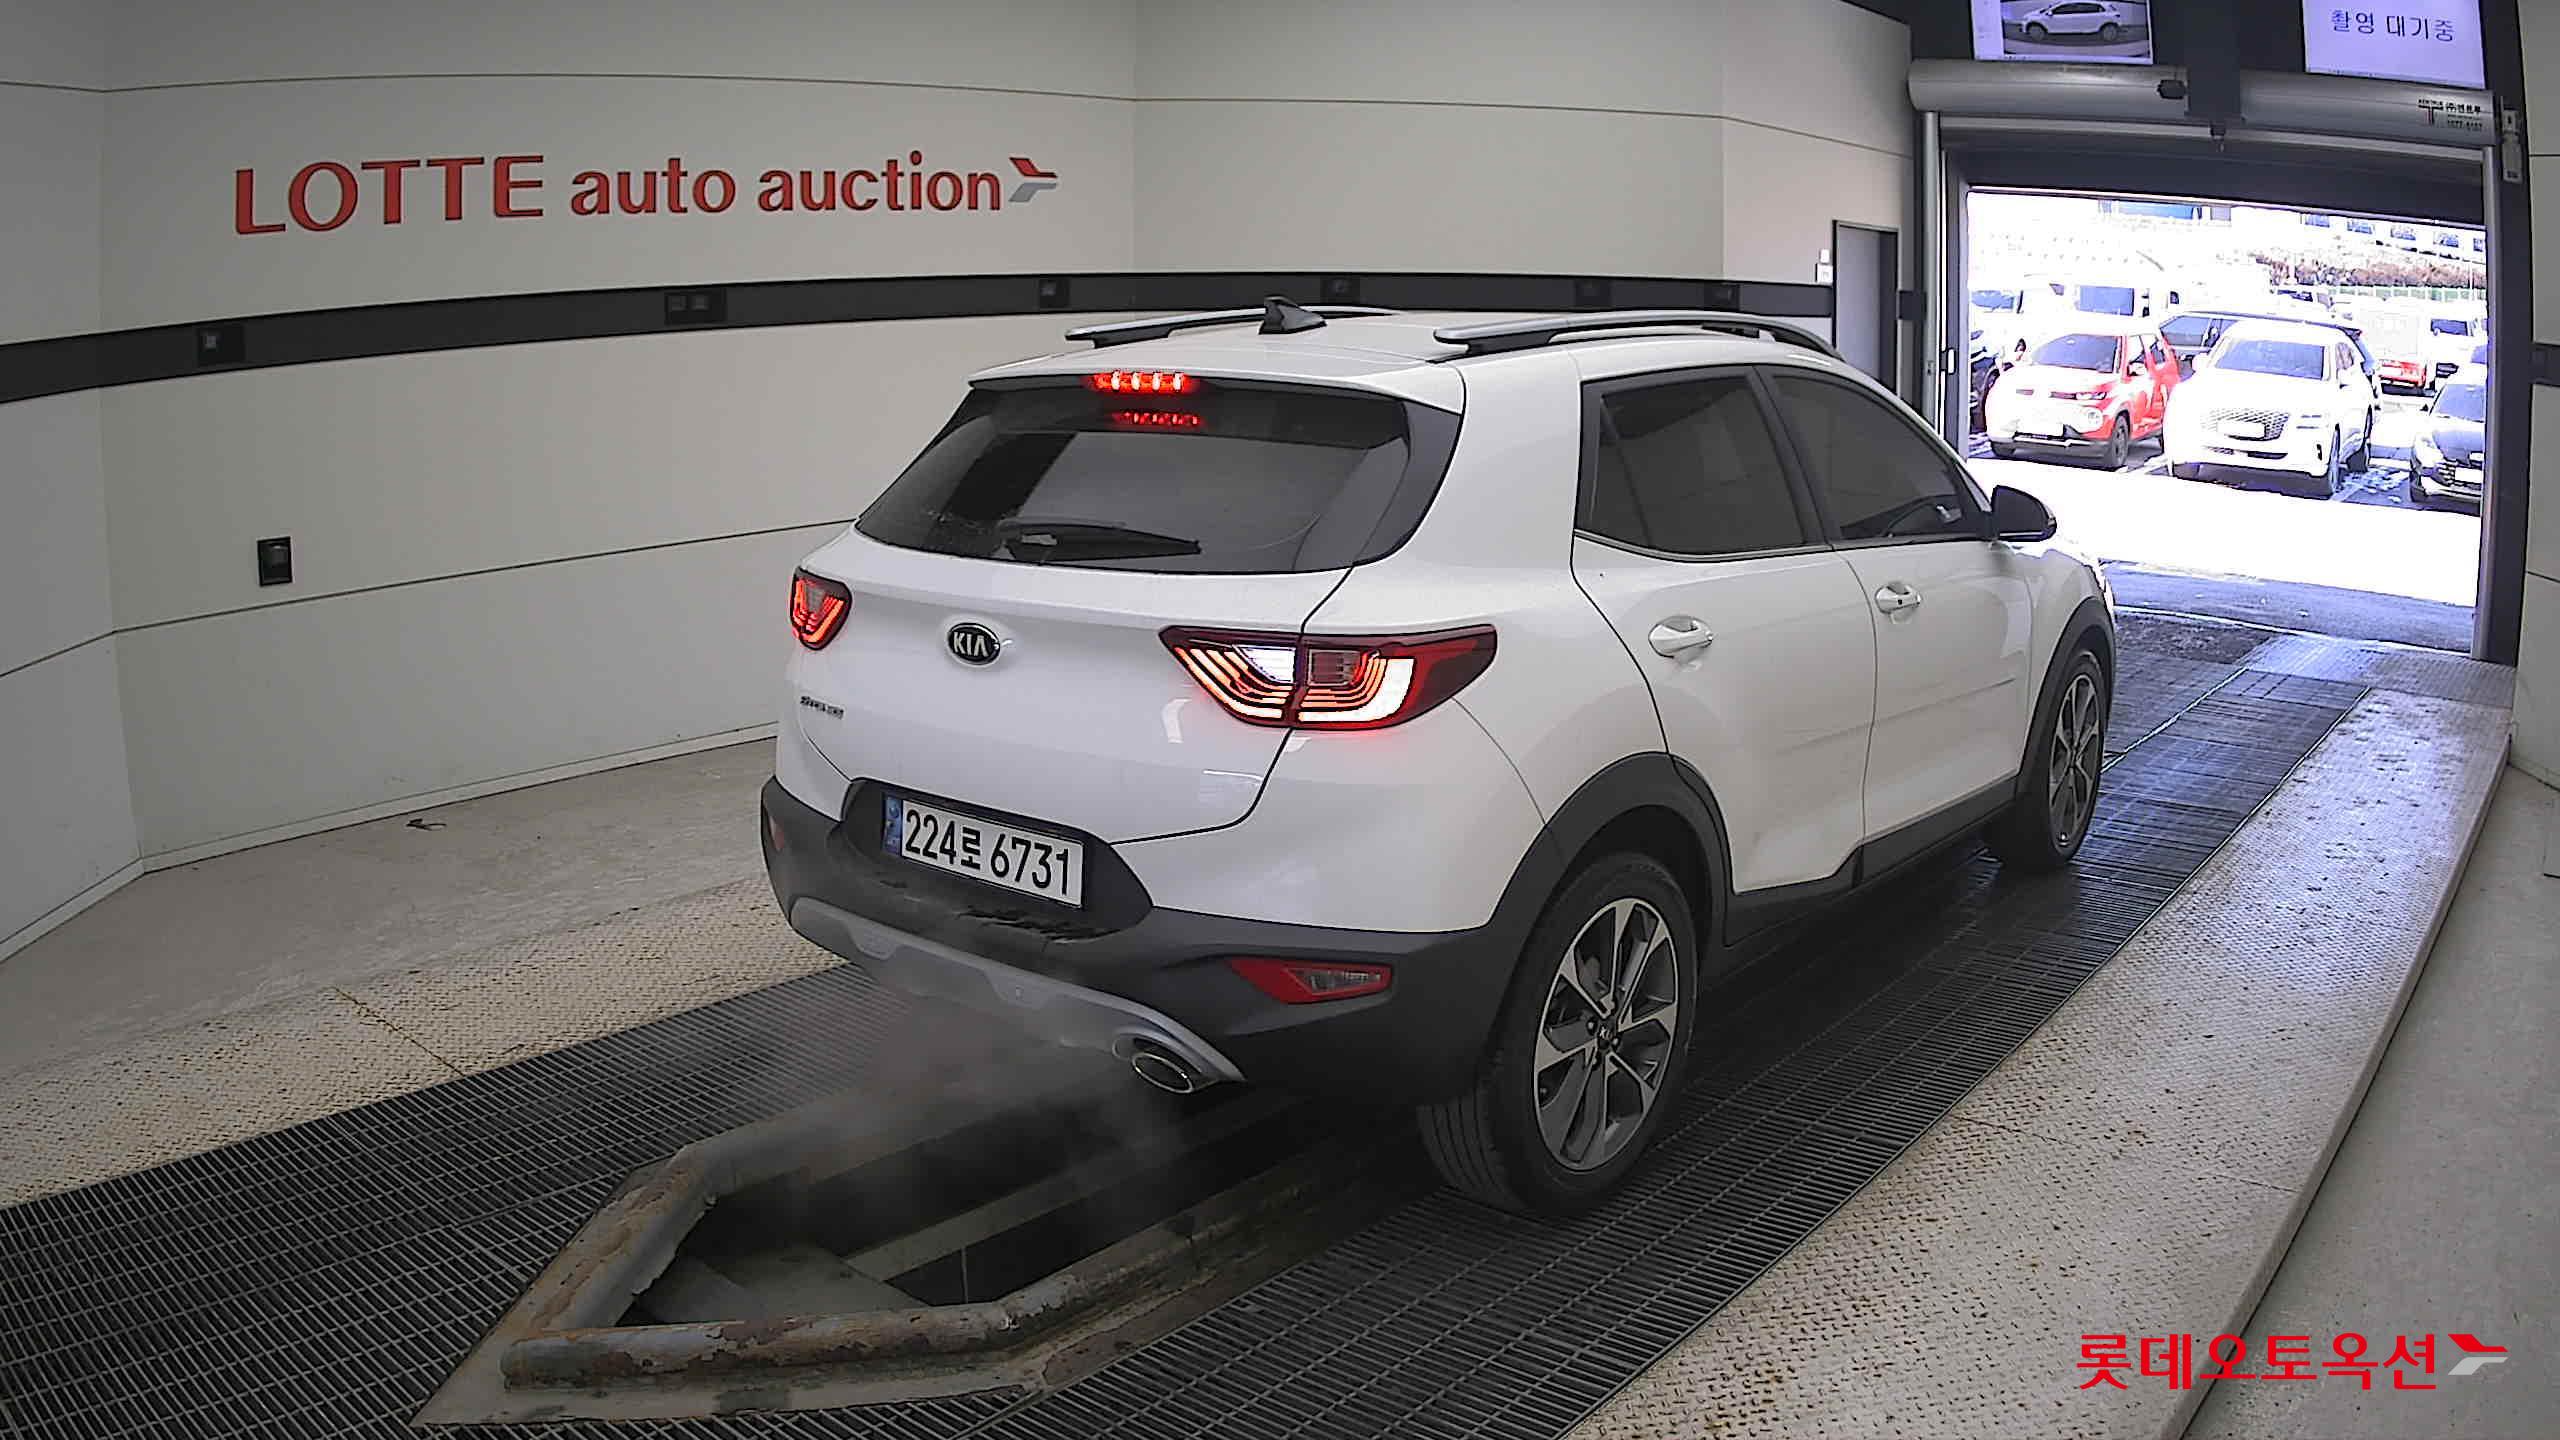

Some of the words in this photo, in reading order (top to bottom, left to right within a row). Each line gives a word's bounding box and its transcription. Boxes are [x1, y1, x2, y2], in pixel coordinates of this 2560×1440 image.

[2331, 8, 2375, 35] 촬영
[2386, 15, 2455, 43] 대기중
[235, 155, 544, 235] LOTTE
[571, 157, 737, 215] auto
[758, 150, 1003, 212] auction
[953, 631, 989, 657] KIA
[905, 809, 981, 871] 224로
[990, 833, 1070, 896] 6731
